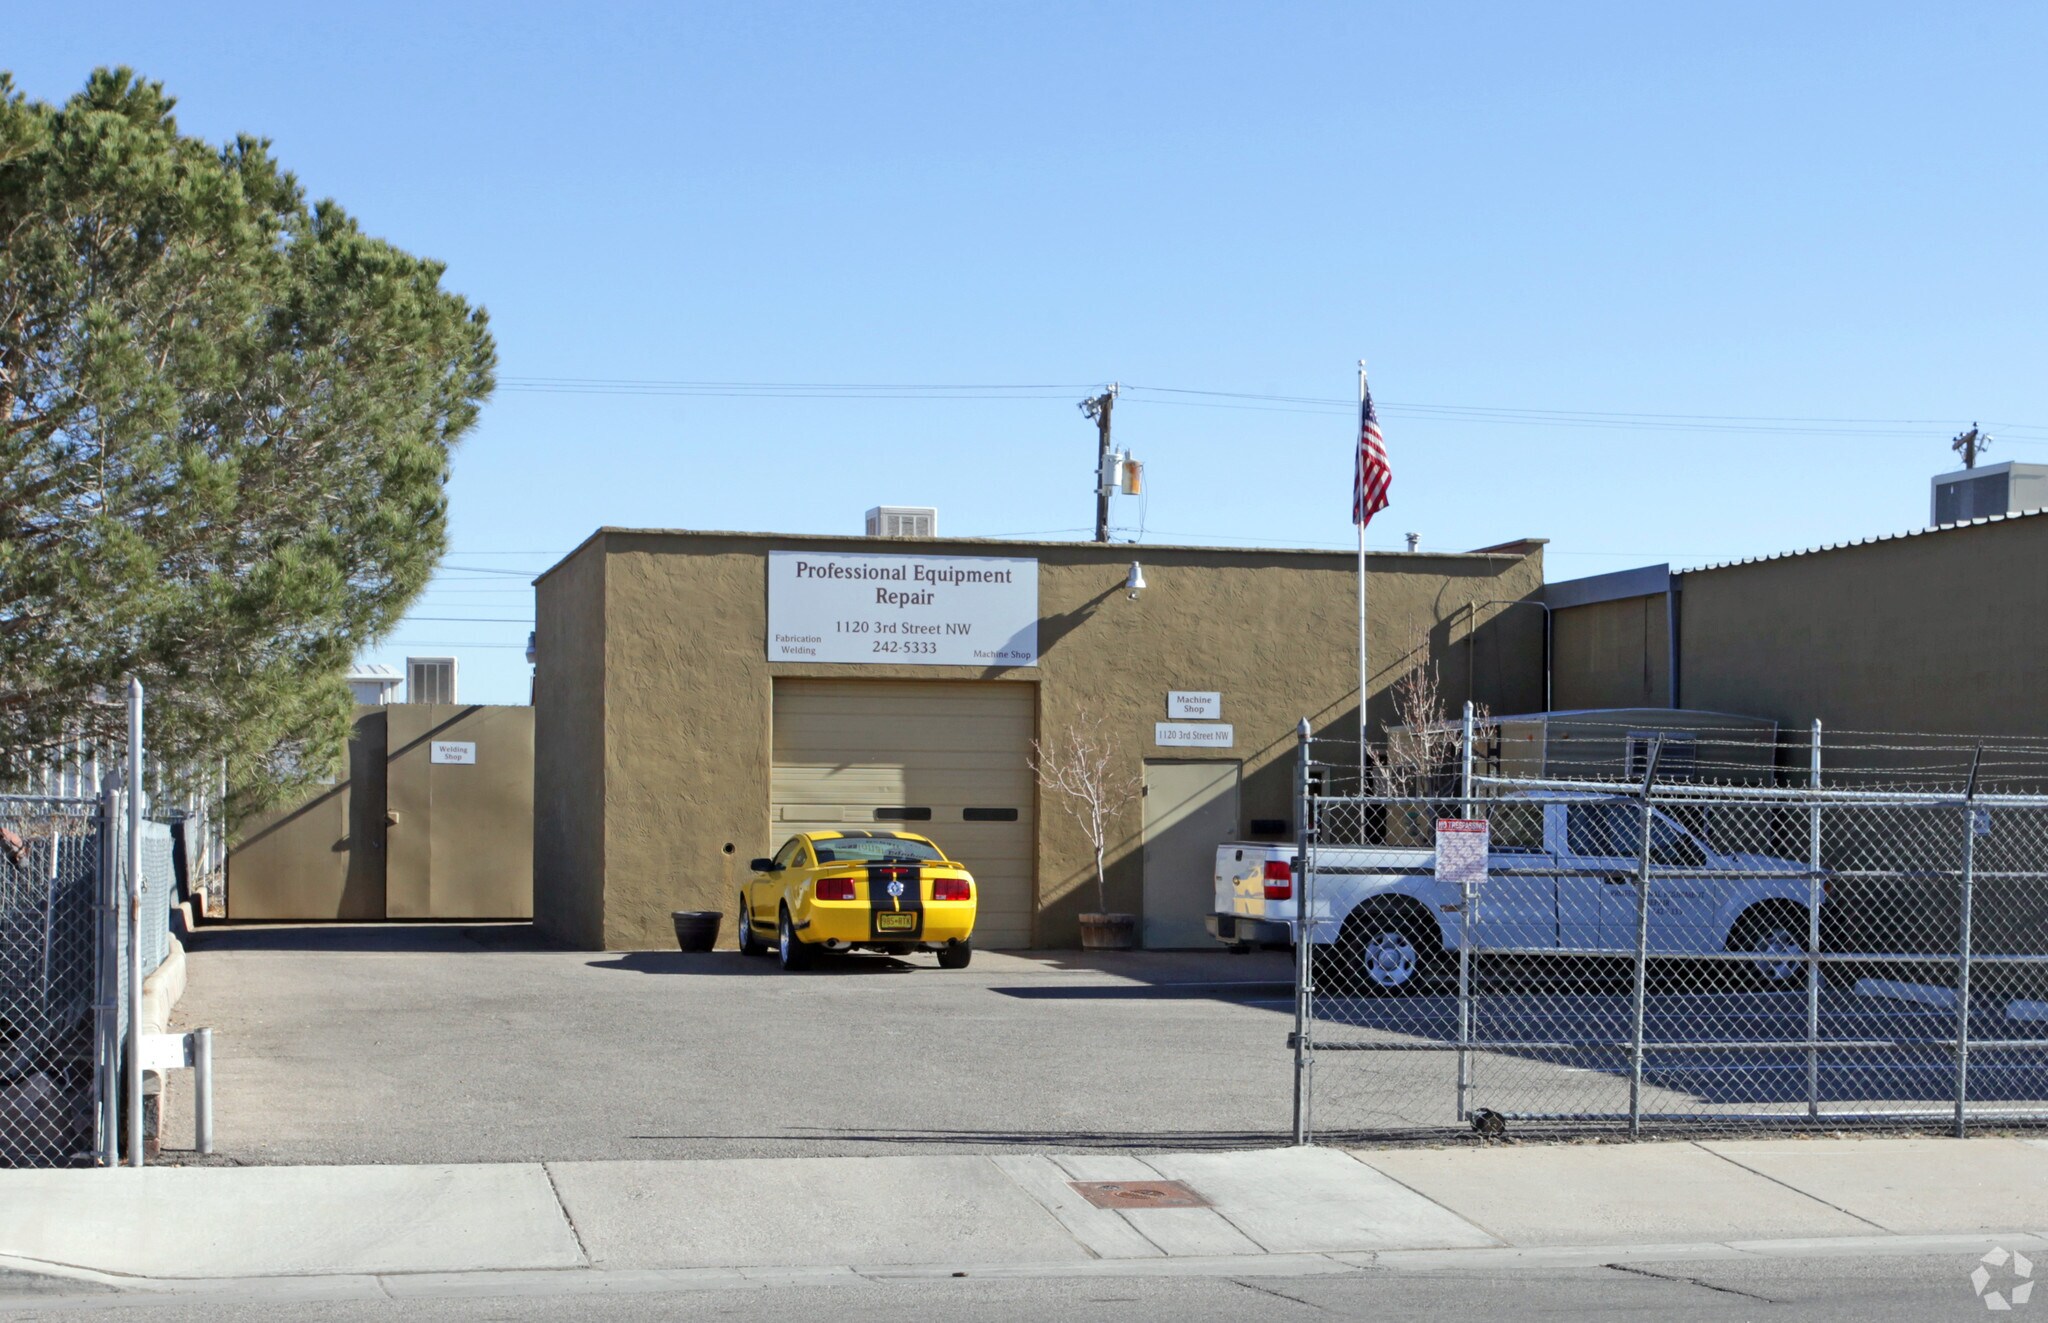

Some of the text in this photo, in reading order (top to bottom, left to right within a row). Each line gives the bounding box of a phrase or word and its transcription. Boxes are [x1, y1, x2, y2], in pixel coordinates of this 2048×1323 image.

[796, 561, 1012, 586] Professional Equipment
[876, 587, 935, 608] Repair
[836, 621, 972, 636] 1120 3rd Street NW
[775, 634, 822, 643] Fabrication
[781, 645, 817, 656] Welding
[872, 641, 938, 654] 242-5333
[973, 650, 1032, 660] Machine Shop
[1176, 696, 1212, 704] Machine
[1184, 705, 1205, 714] Shop
[1159, 730, 1229, 740] 1120 3rd Street NW
[439, 746, 468, 754] Welding
[444, 753, 463, 761] Shop
